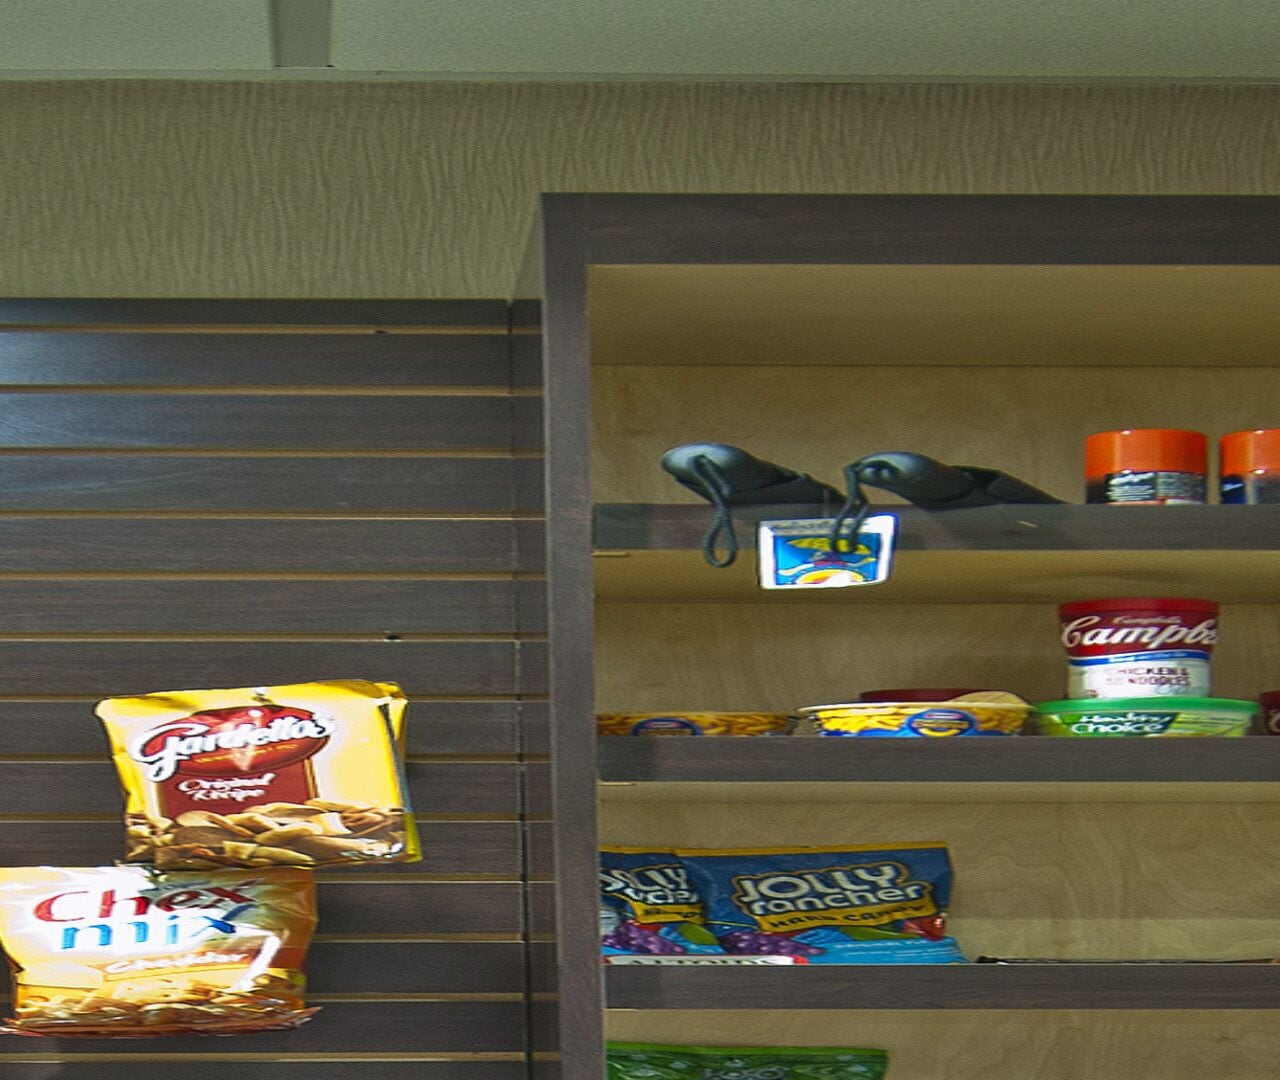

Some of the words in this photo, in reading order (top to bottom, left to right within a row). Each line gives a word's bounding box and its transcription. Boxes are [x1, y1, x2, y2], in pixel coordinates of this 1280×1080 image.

[1072, 722, 1164, 734] Choice
[32, 883, 257, 923] Chex
[737, 865, 897, 903] JOLLY
[749, 884, 922, 916] rancher
[61, 905, 254, 950] mix
